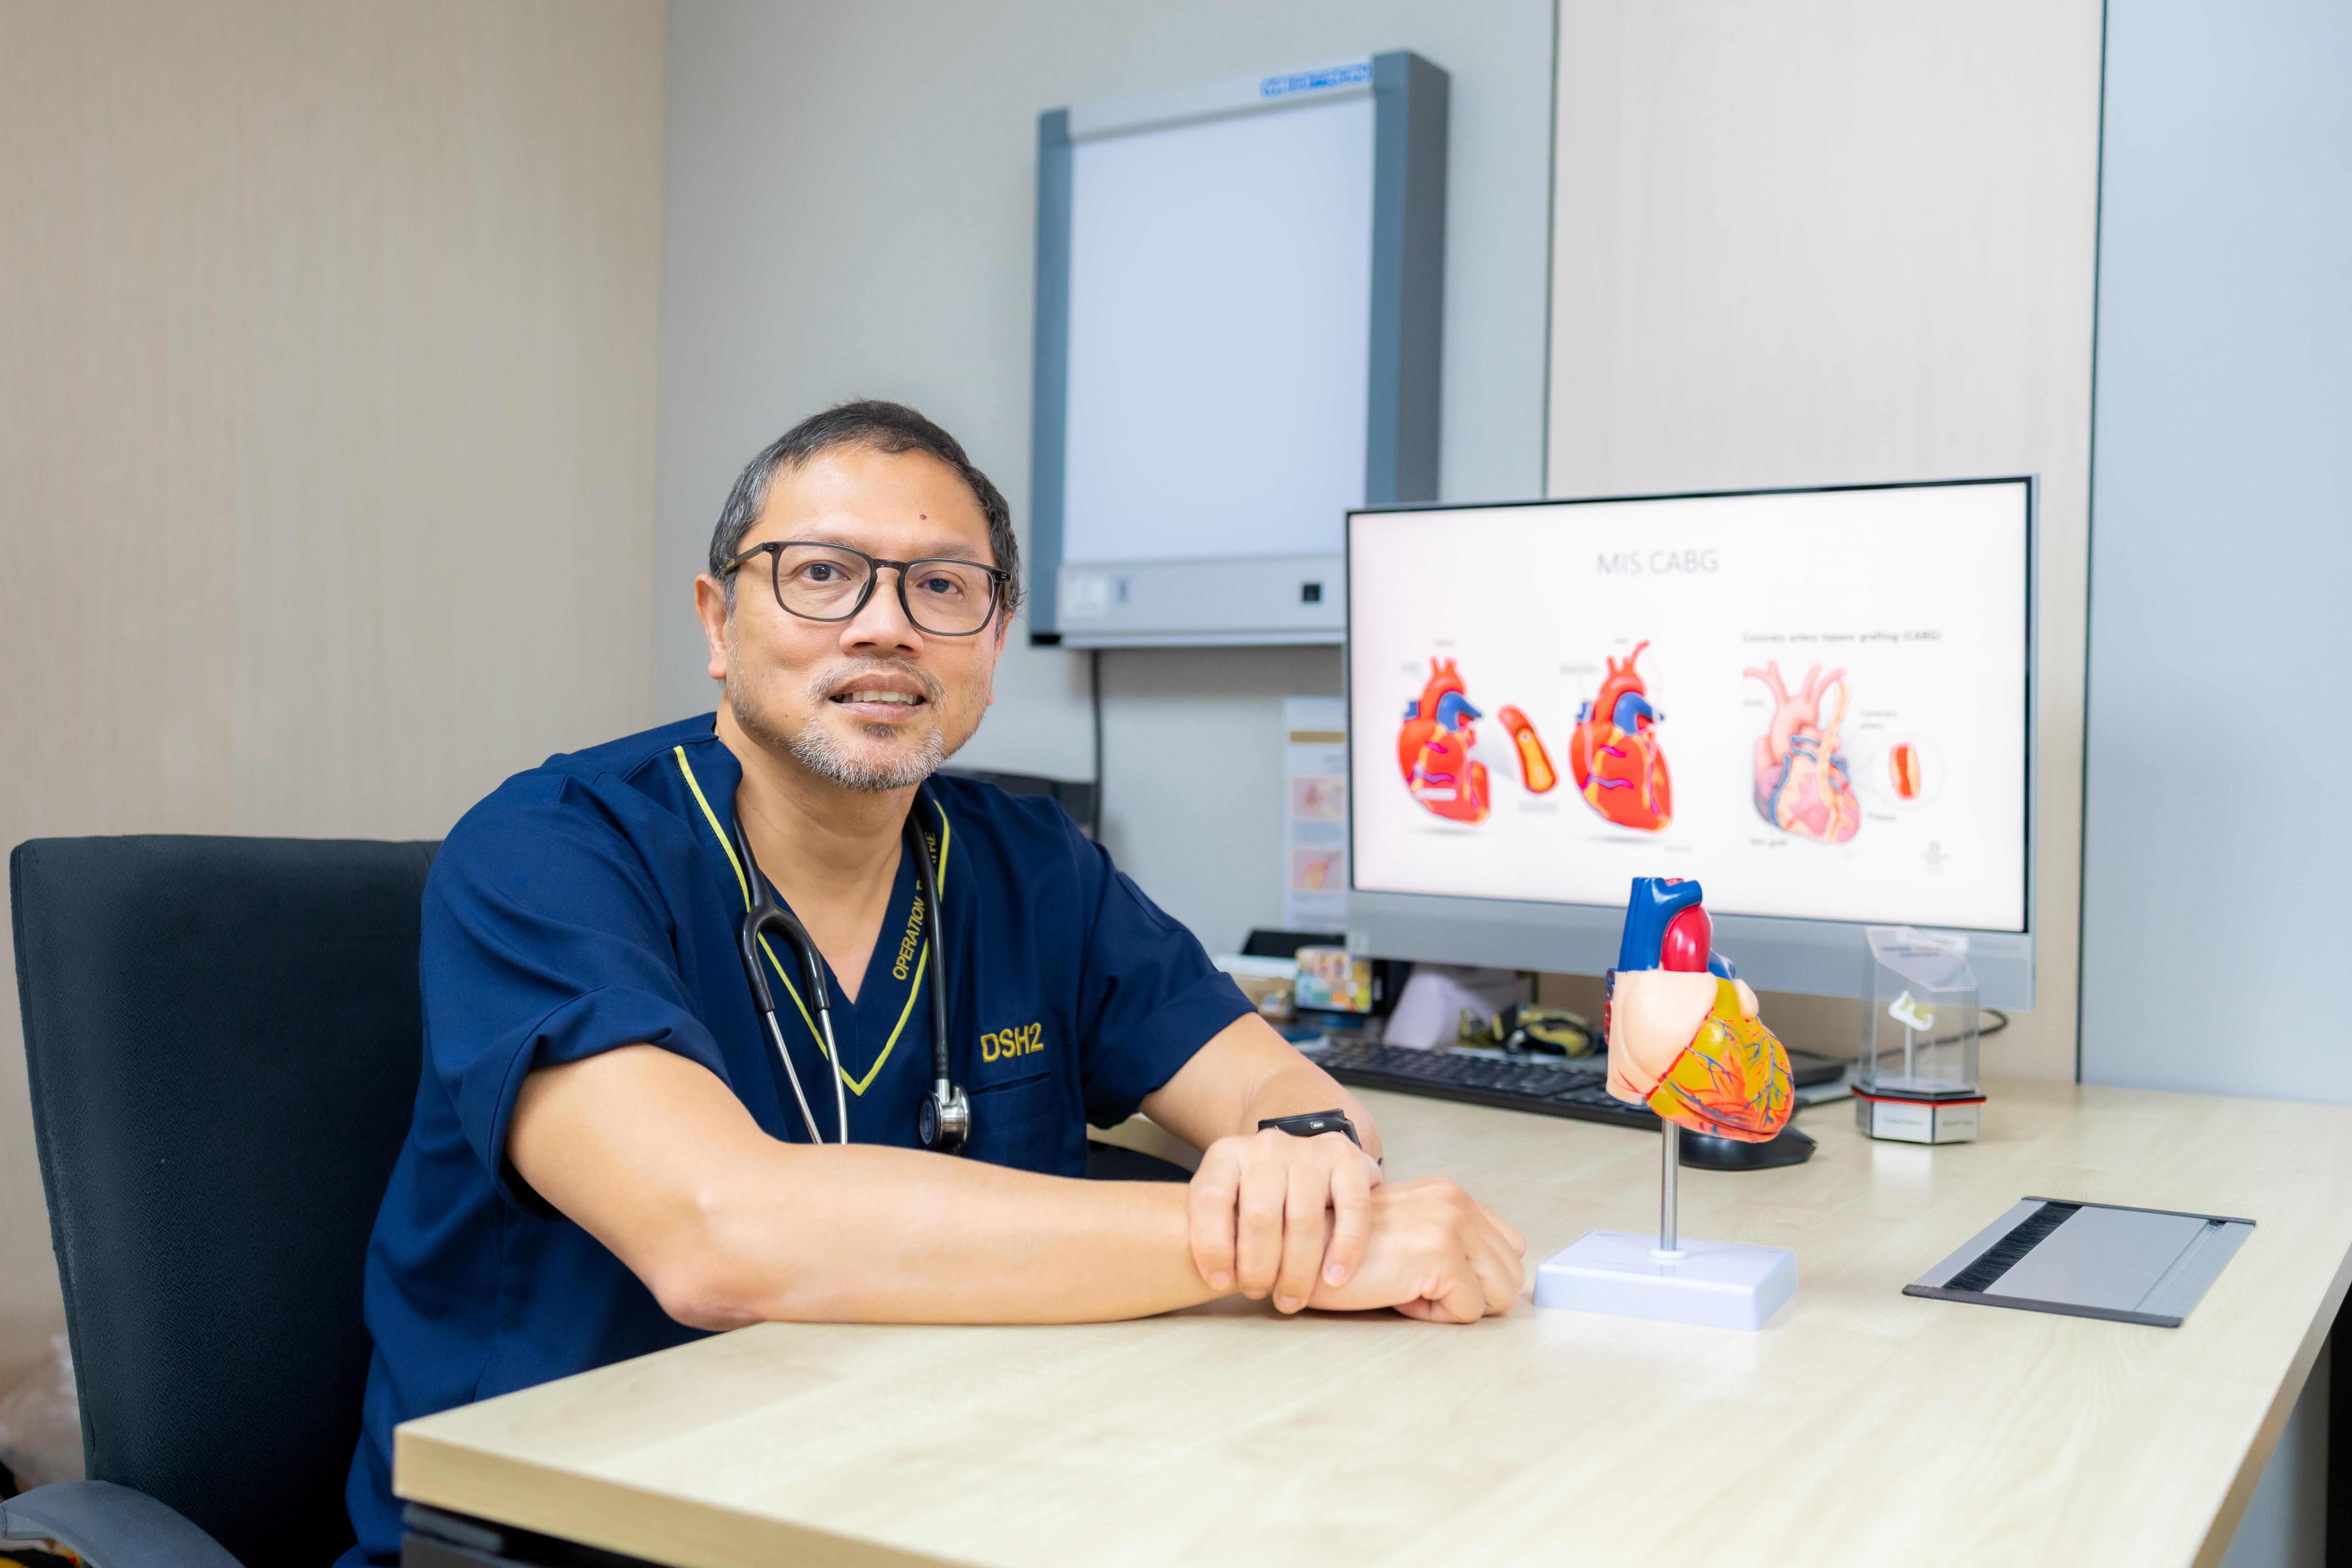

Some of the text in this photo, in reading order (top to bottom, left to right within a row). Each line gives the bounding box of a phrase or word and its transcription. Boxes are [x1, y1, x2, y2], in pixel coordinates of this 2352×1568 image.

[1596, 547, 1718, 576] MIS CABG
[1903, 629, 1941, 642] (CABG)
[892, 895, 925, 980] OPERATION
[980, 1022, 1044, 1063] DSH2
